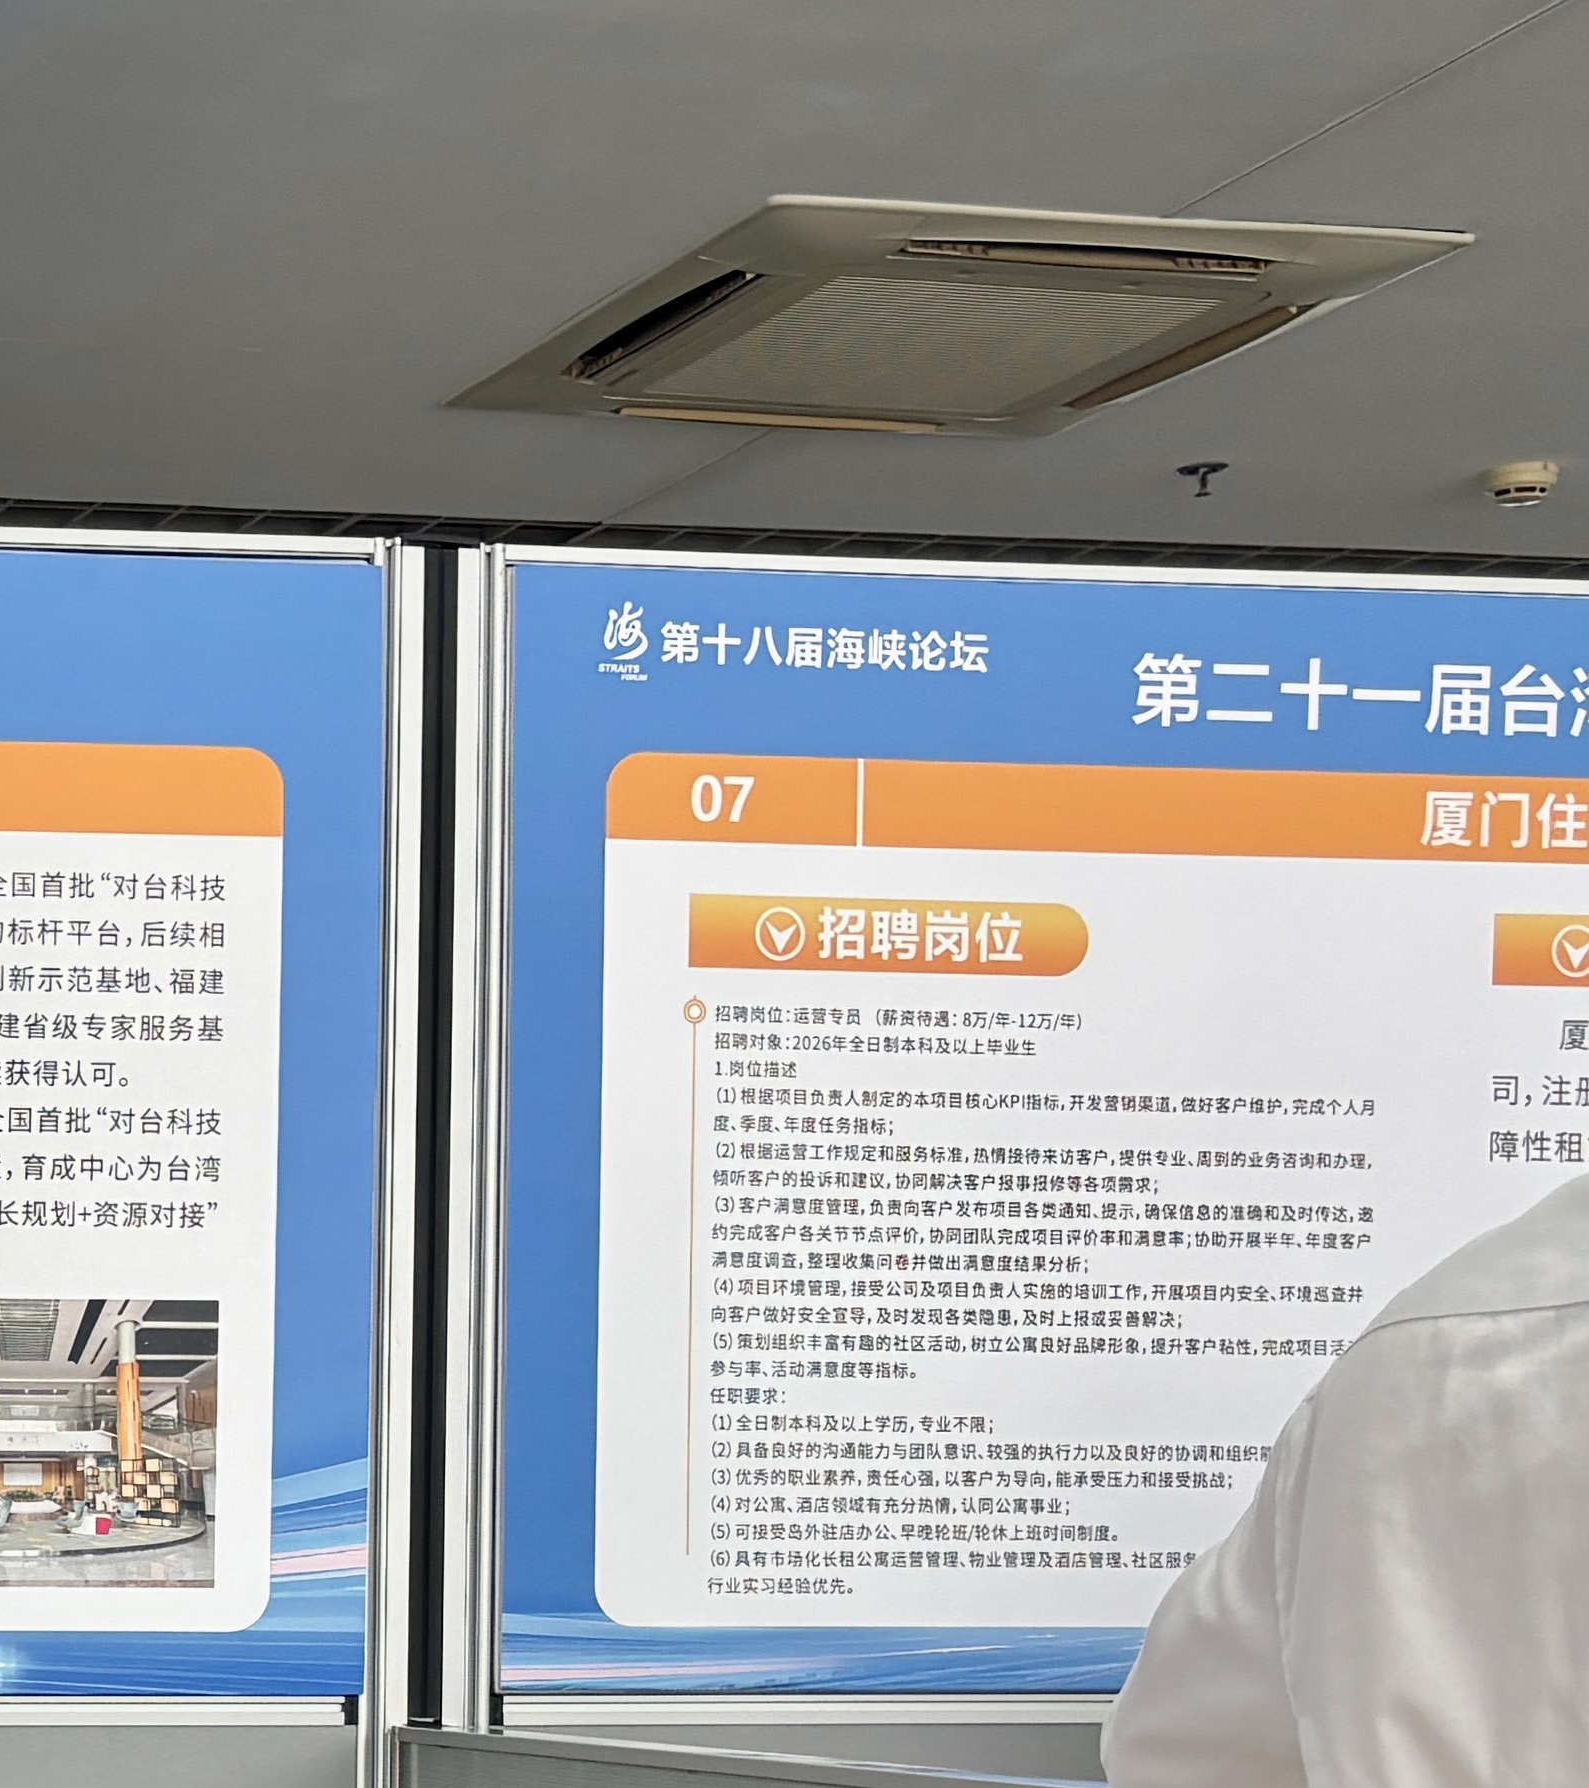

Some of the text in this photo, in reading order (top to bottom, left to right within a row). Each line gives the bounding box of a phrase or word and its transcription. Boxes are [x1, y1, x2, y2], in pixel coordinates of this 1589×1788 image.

[660, 621, 989, 674] 第十八届海峡论坛
[689, 776, 755, 823] 07
[1421, 791, 1589, 849] 厦门住
[817, 907, 1022, 962] 招聘岗位
[715, 1005, 860, 1025] 招聘岗位：运营专员
[1489, 1130, 1589, 1163] 障性租
